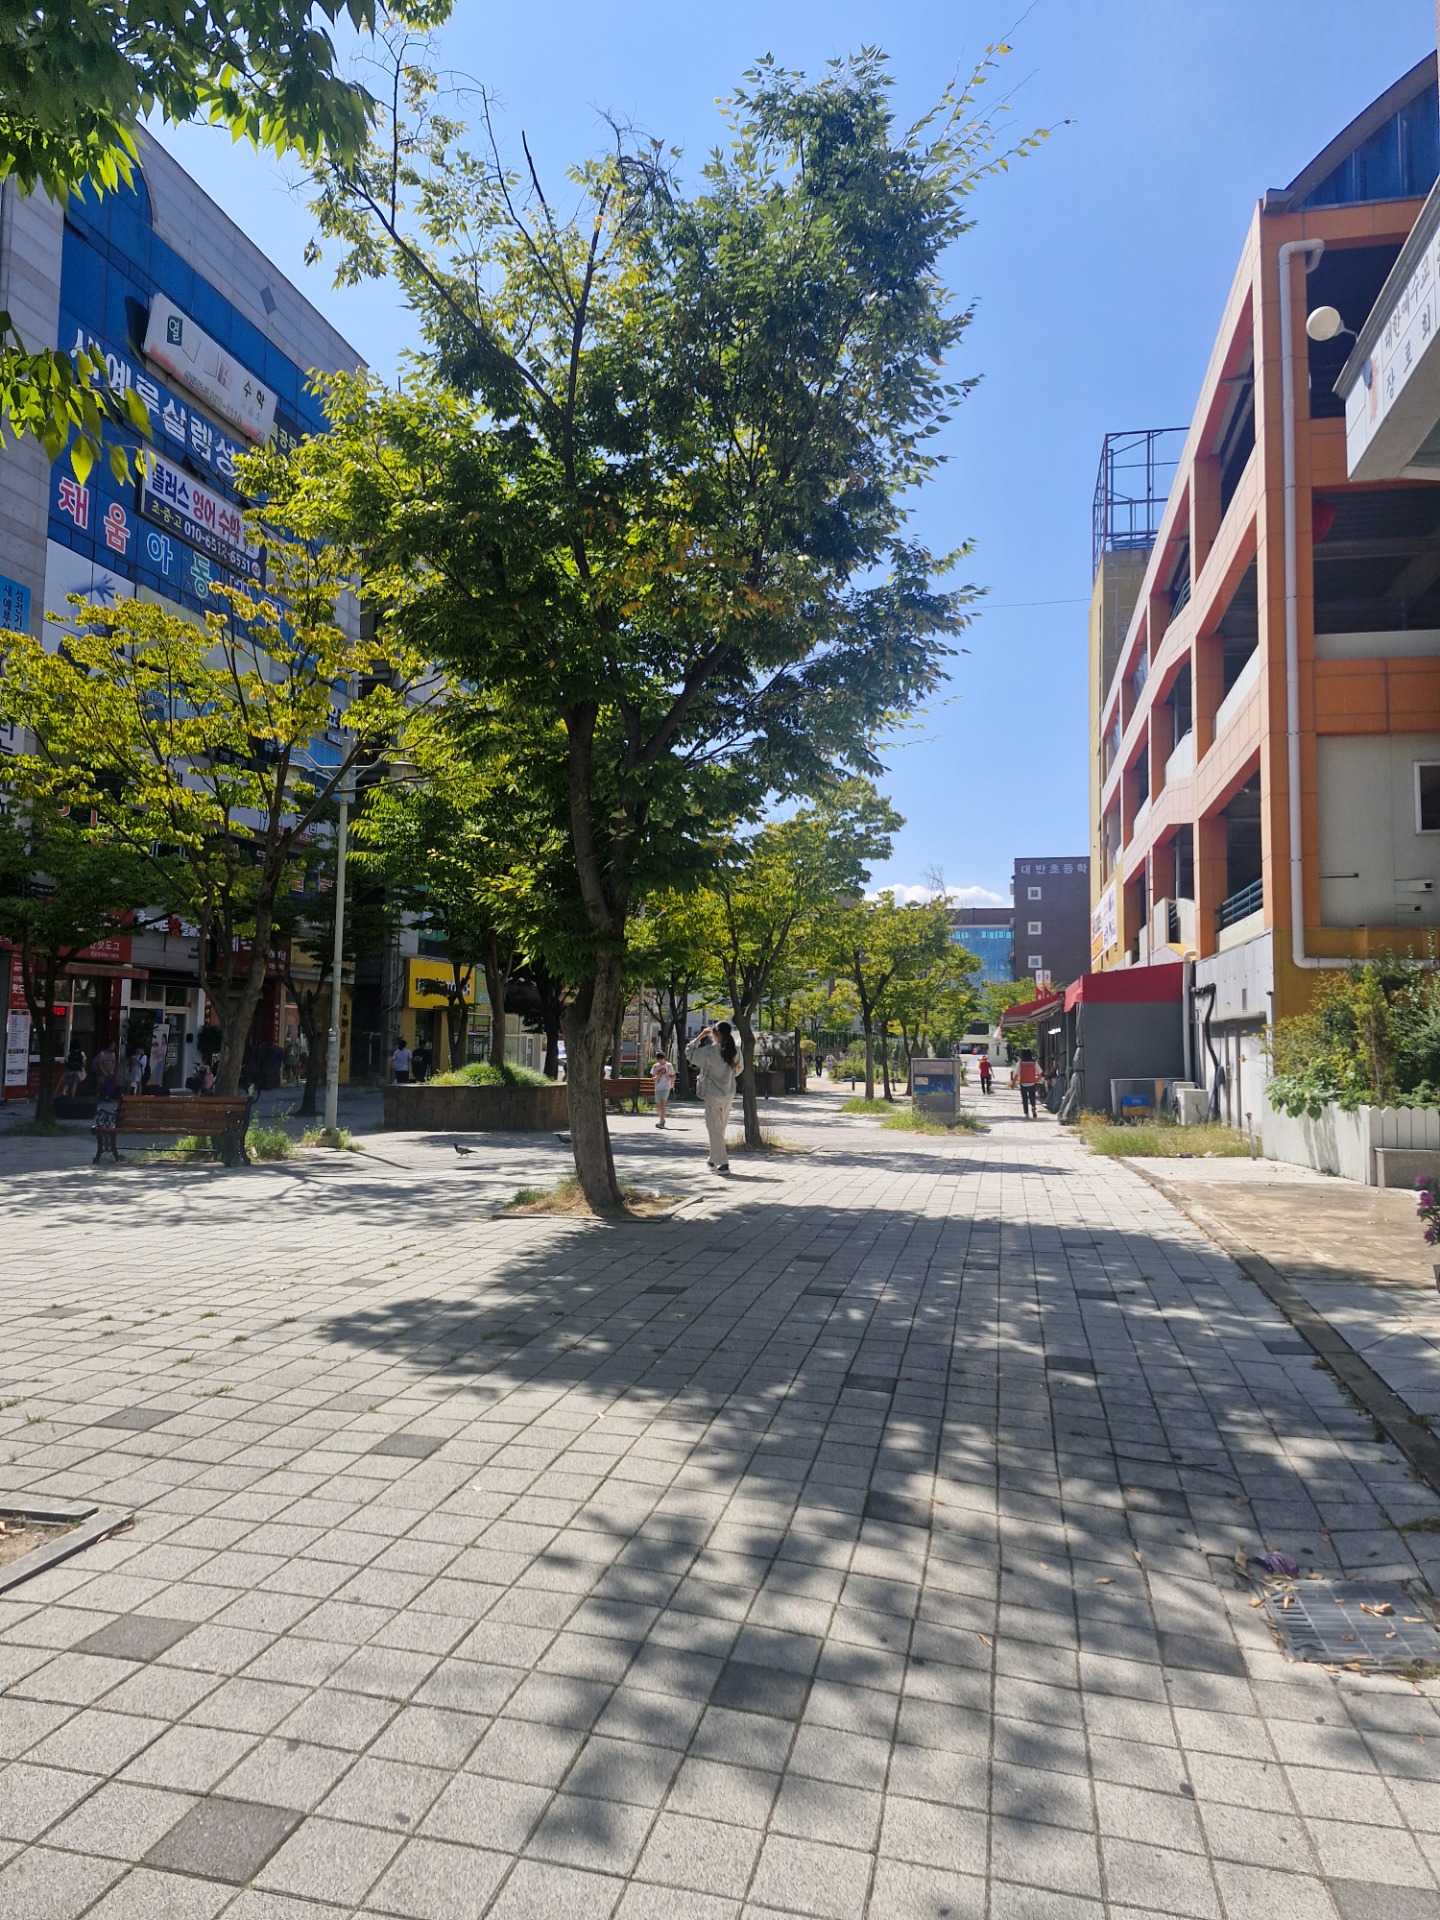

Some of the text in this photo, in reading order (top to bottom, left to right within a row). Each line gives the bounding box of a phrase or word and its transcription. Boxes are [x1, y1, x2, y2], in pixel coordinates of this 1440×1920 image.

[1385, 303, 1431, 400] 장로회
[243, 380, 266, 410] 수학
[152, 462, 189, 510] 플러스
[192, 490, 216, 530] 영어
[218, 509, 241, 545] 수학
[1020, 863, 1088, 875] 대반초등학
